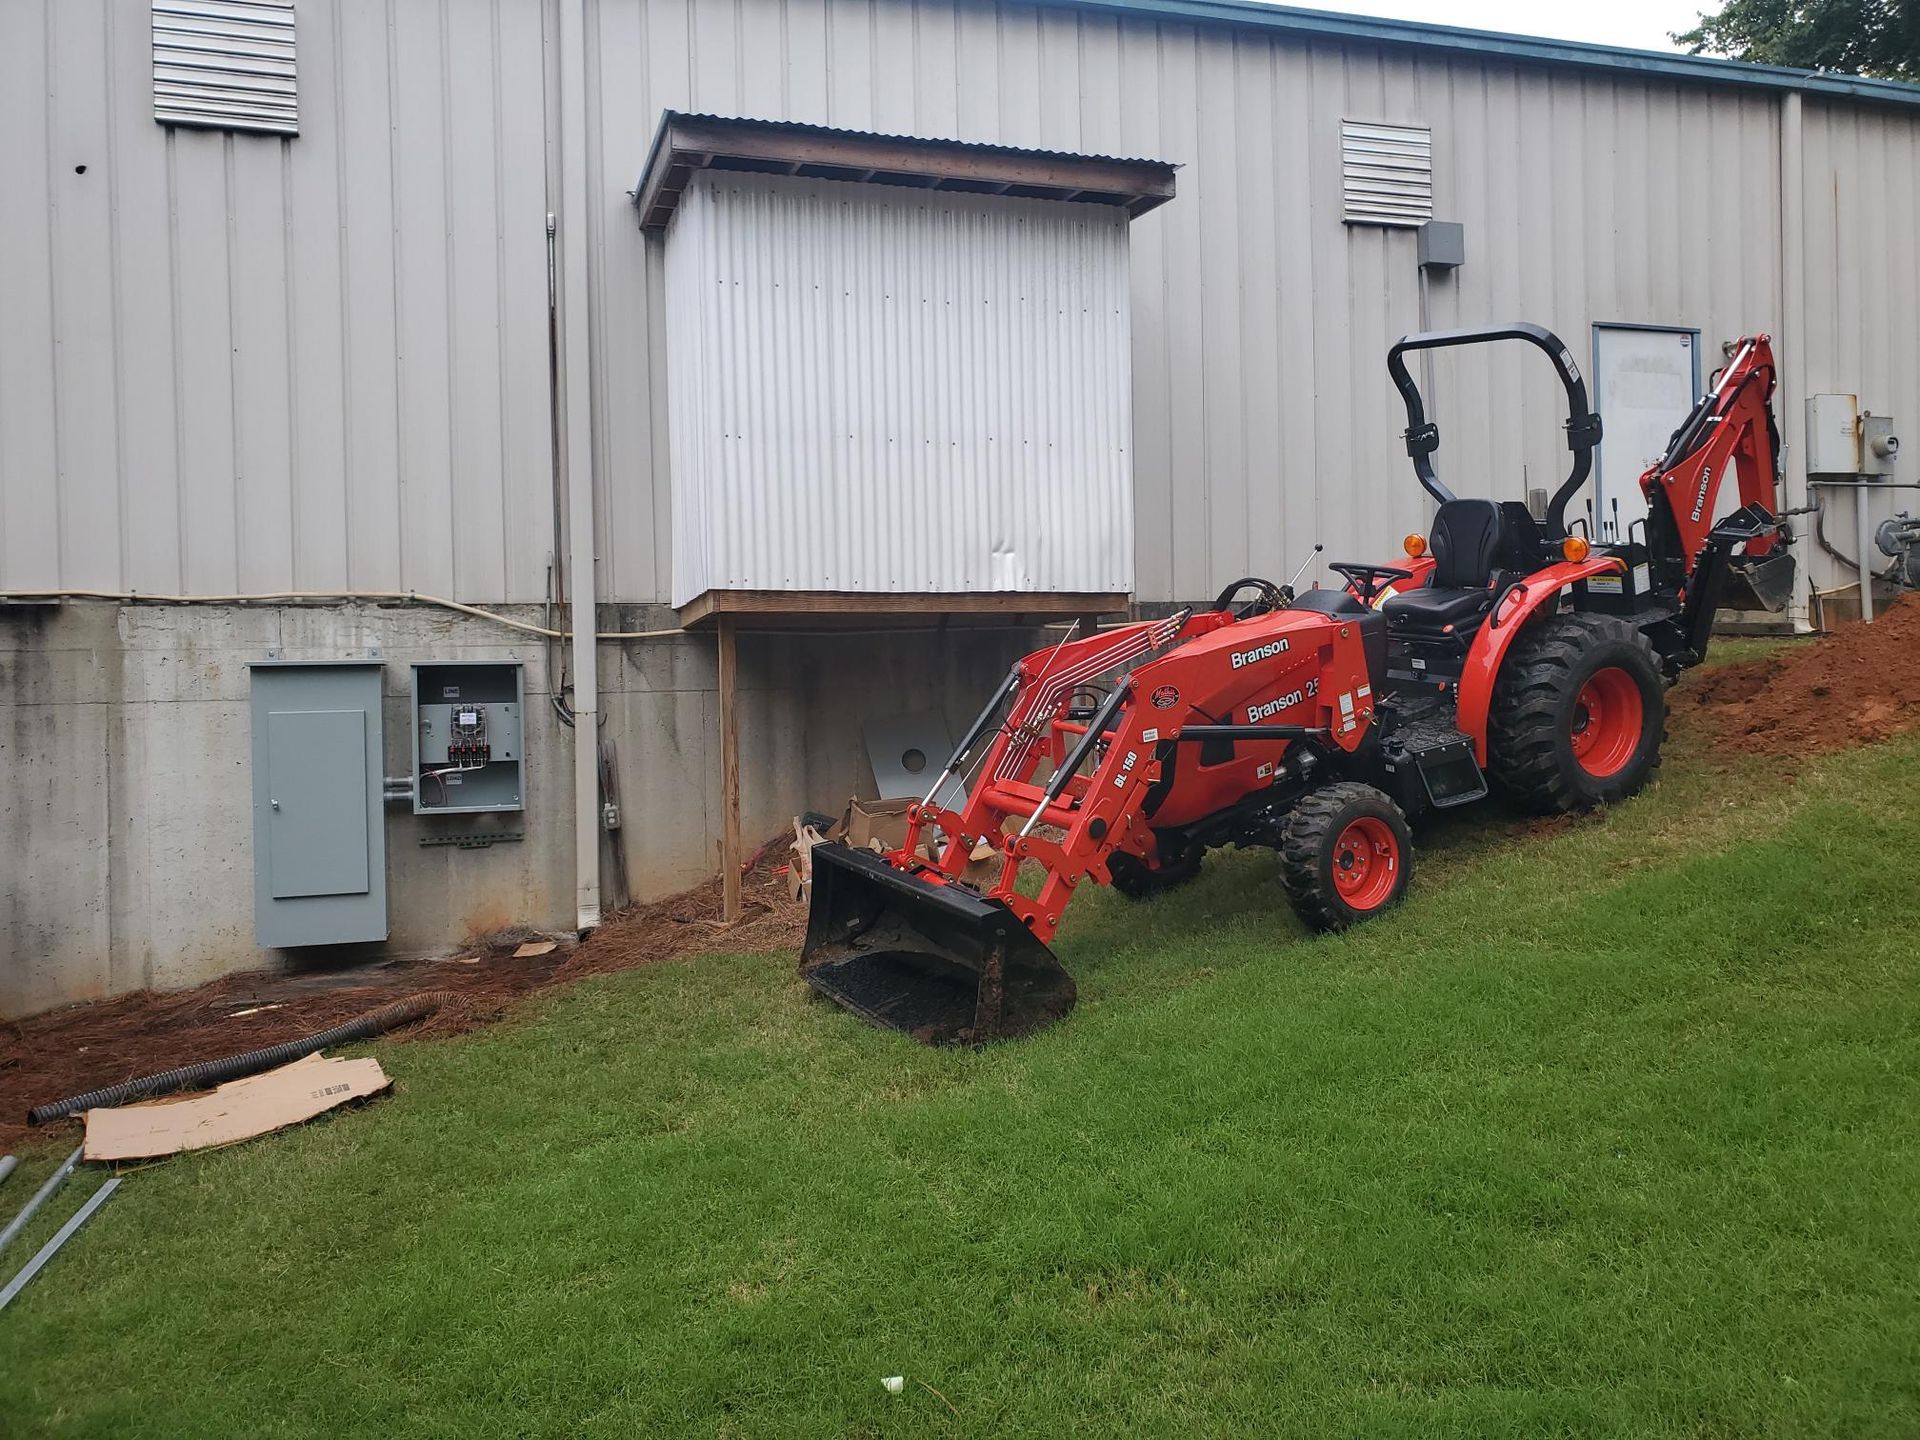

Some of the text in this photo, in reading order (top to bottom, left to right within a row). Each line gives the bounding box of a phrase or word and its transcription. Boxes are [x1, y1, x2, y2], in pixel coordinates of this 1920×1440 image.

[1691, 466, 1711, 521] Branson
[1231, 638, 1289, 669] Branson
[1247, 689, 1303, 723] Branson
[1113, 750, 1137, 788] BL 150
